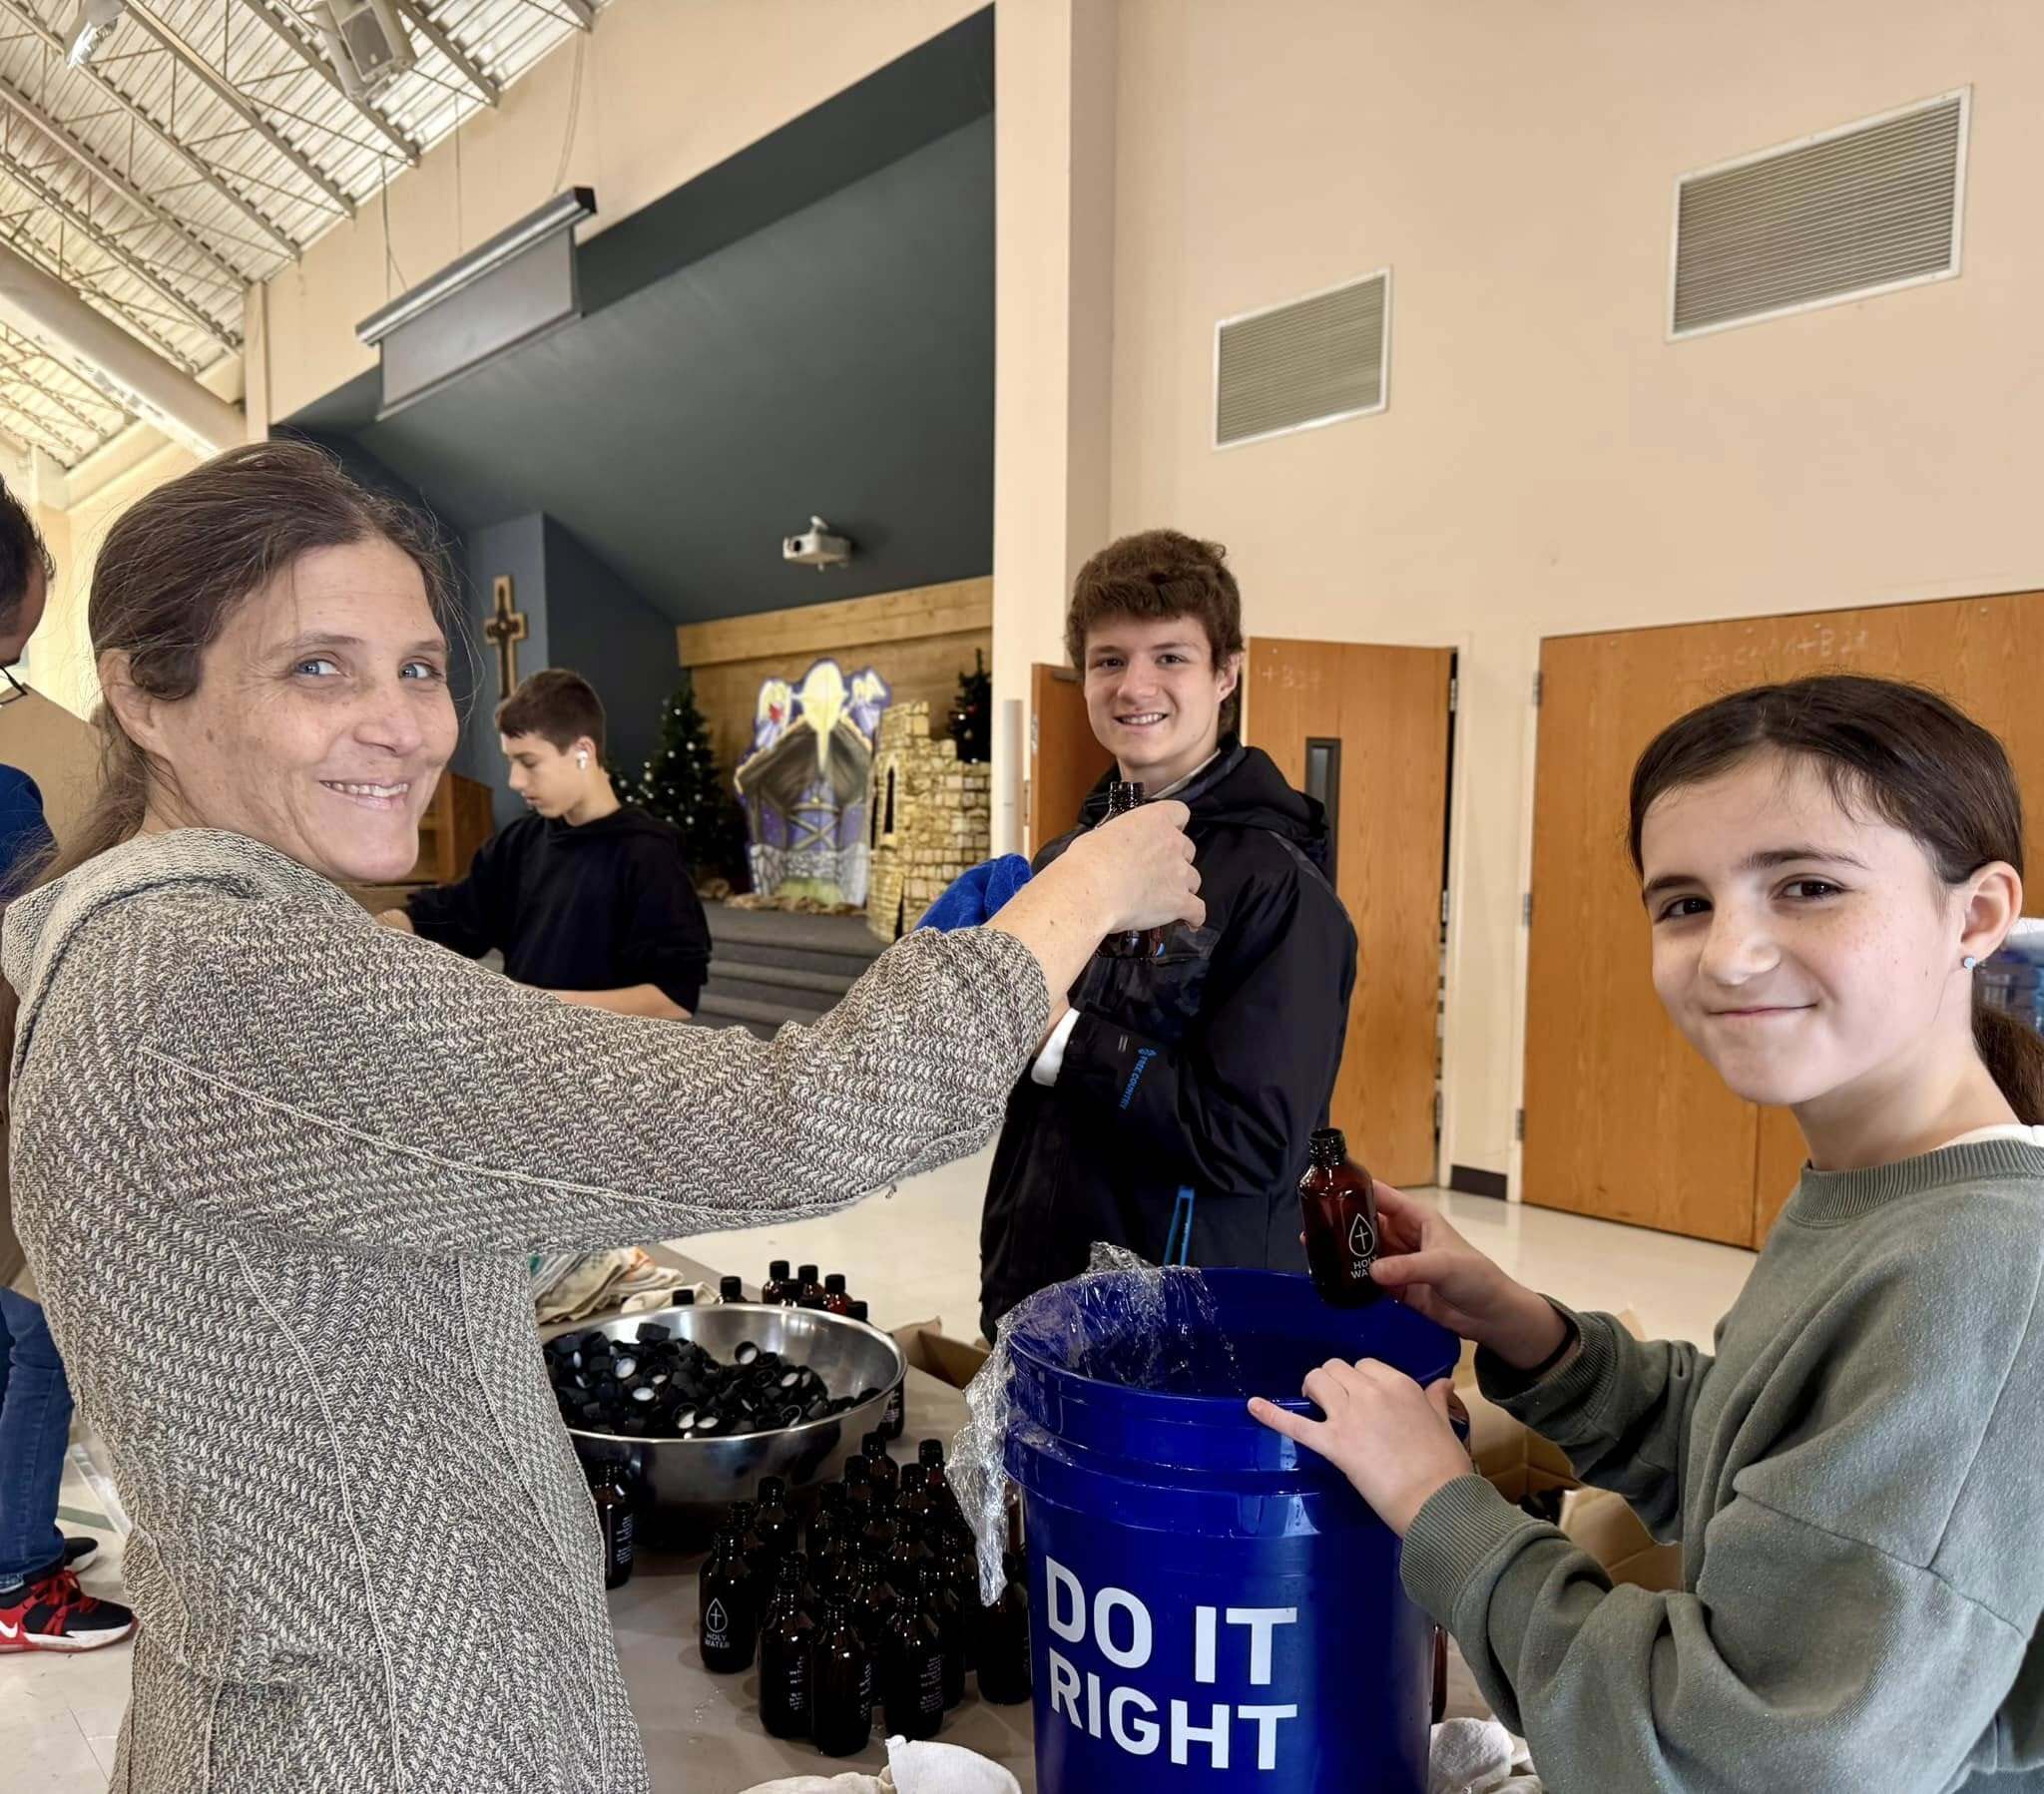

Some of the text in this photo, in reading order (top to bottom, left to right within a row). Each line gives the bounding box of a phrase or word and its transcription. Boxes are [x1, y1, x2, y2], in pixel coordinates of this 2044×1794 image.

[1119, 1056, 1148, 1111] FREE COUNTRY
[704, 1637, 731, 1648] WATER
[706, 1631, 728, 1641] HOLY
[1046, 1555, 1297, 1685] DO IT
[1049, 1646, 1297, 1770] RIGHT
